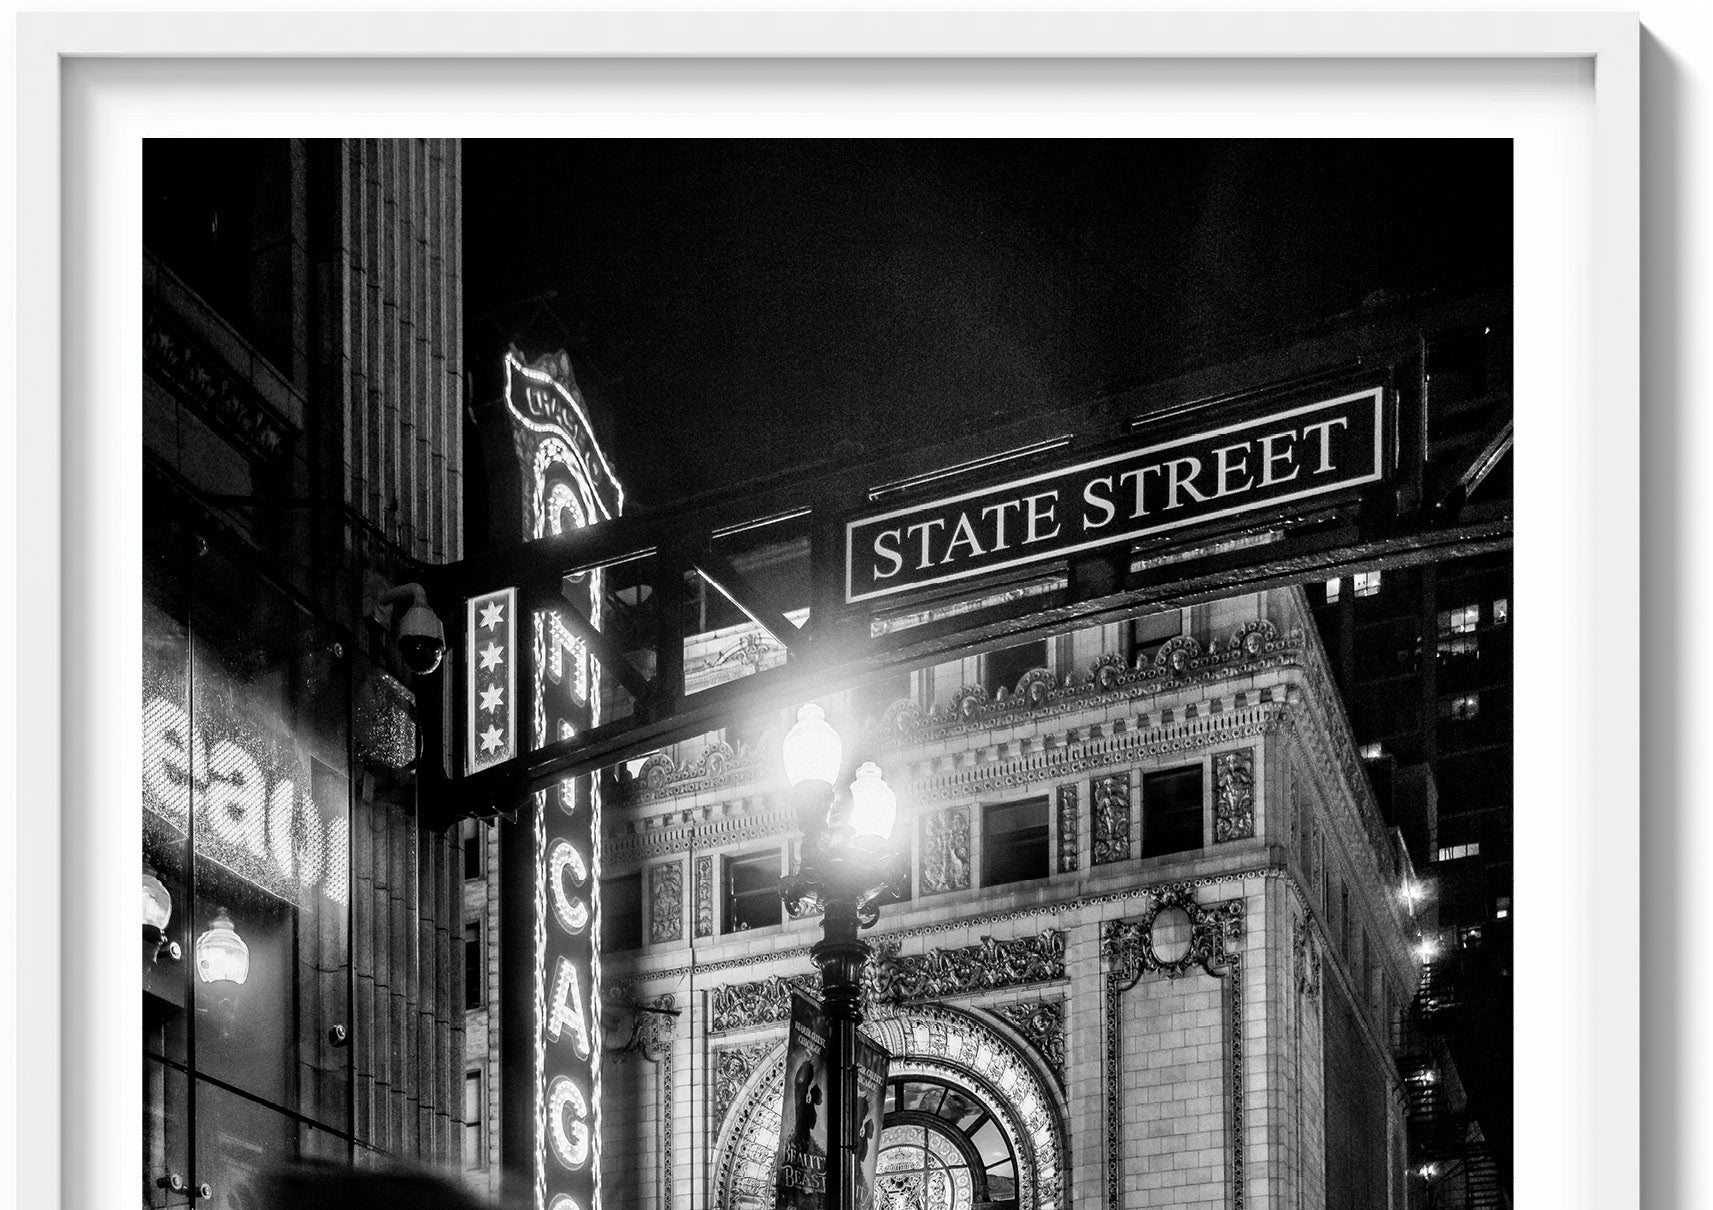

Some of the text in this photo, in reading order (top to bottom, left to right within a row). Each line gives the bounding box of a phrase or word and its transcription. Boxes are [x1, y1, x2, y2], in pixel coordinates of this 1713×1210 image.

[872, 417, 1348, 581] STATE STREET
[782, 1165, 826, 1193] BEAST
